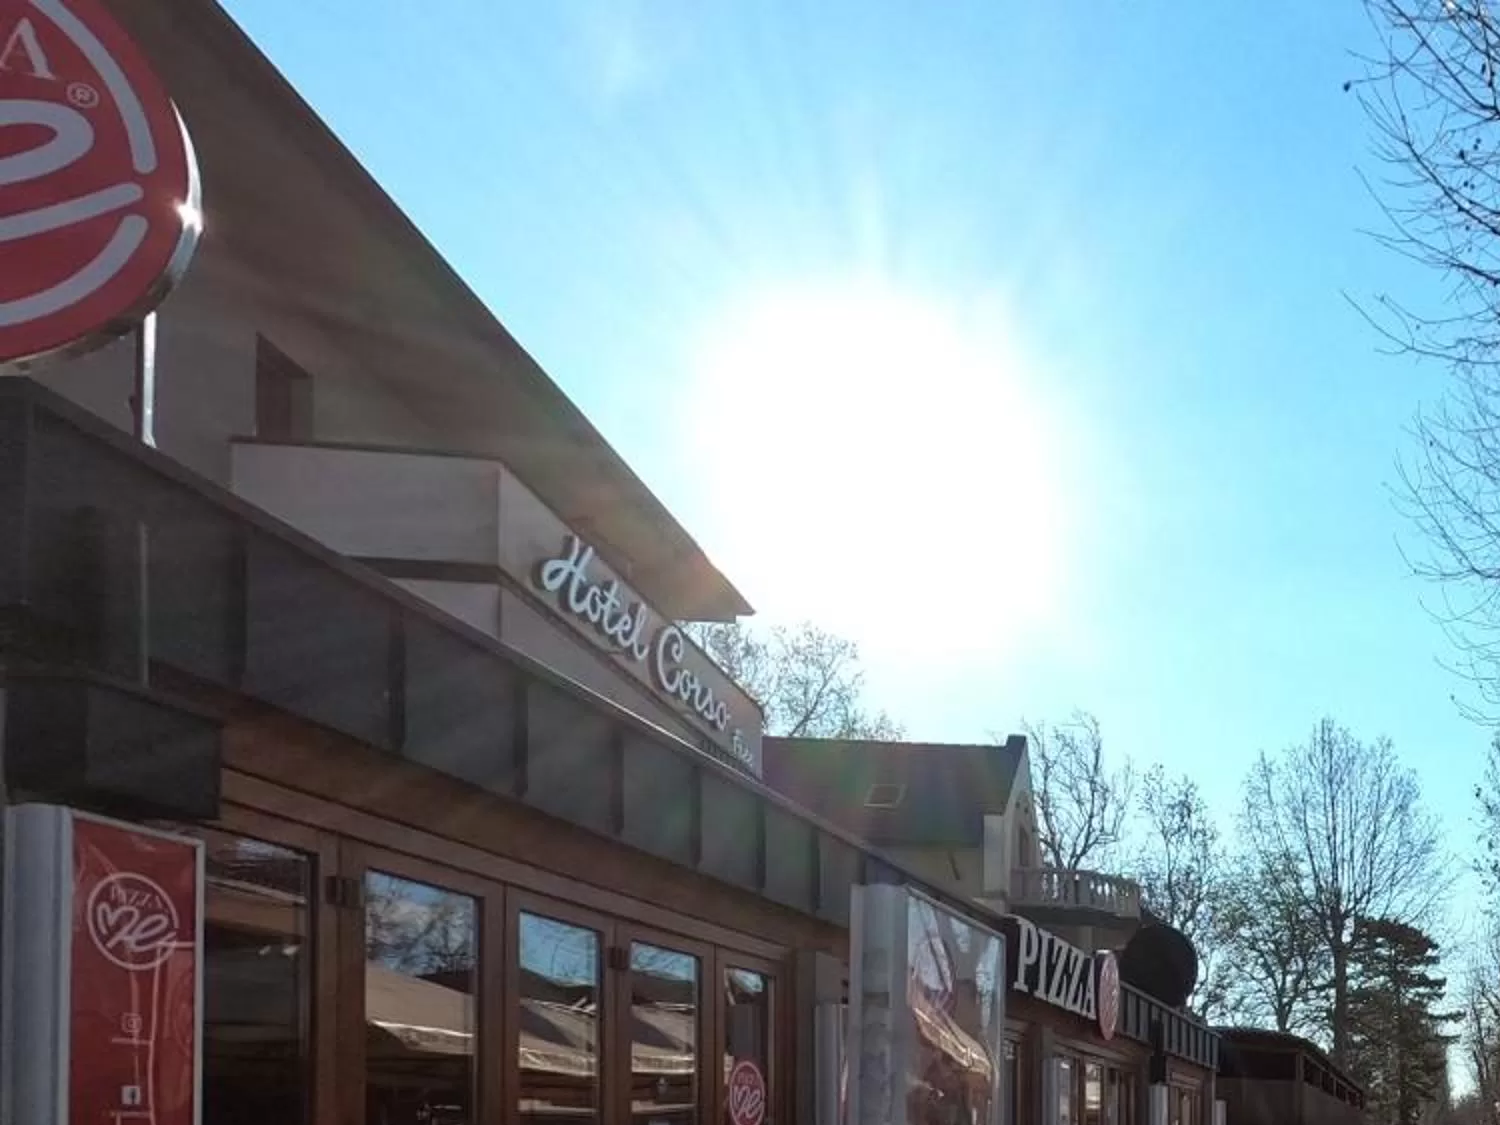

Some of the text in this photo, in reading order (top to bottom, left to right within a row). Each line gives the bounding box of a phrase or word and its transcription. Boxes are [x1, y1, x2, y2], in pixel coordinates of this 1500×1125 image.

[542, 535, 732, 731] Hotel Corso
[1013, 916, 1097, 1021] PIZZA
